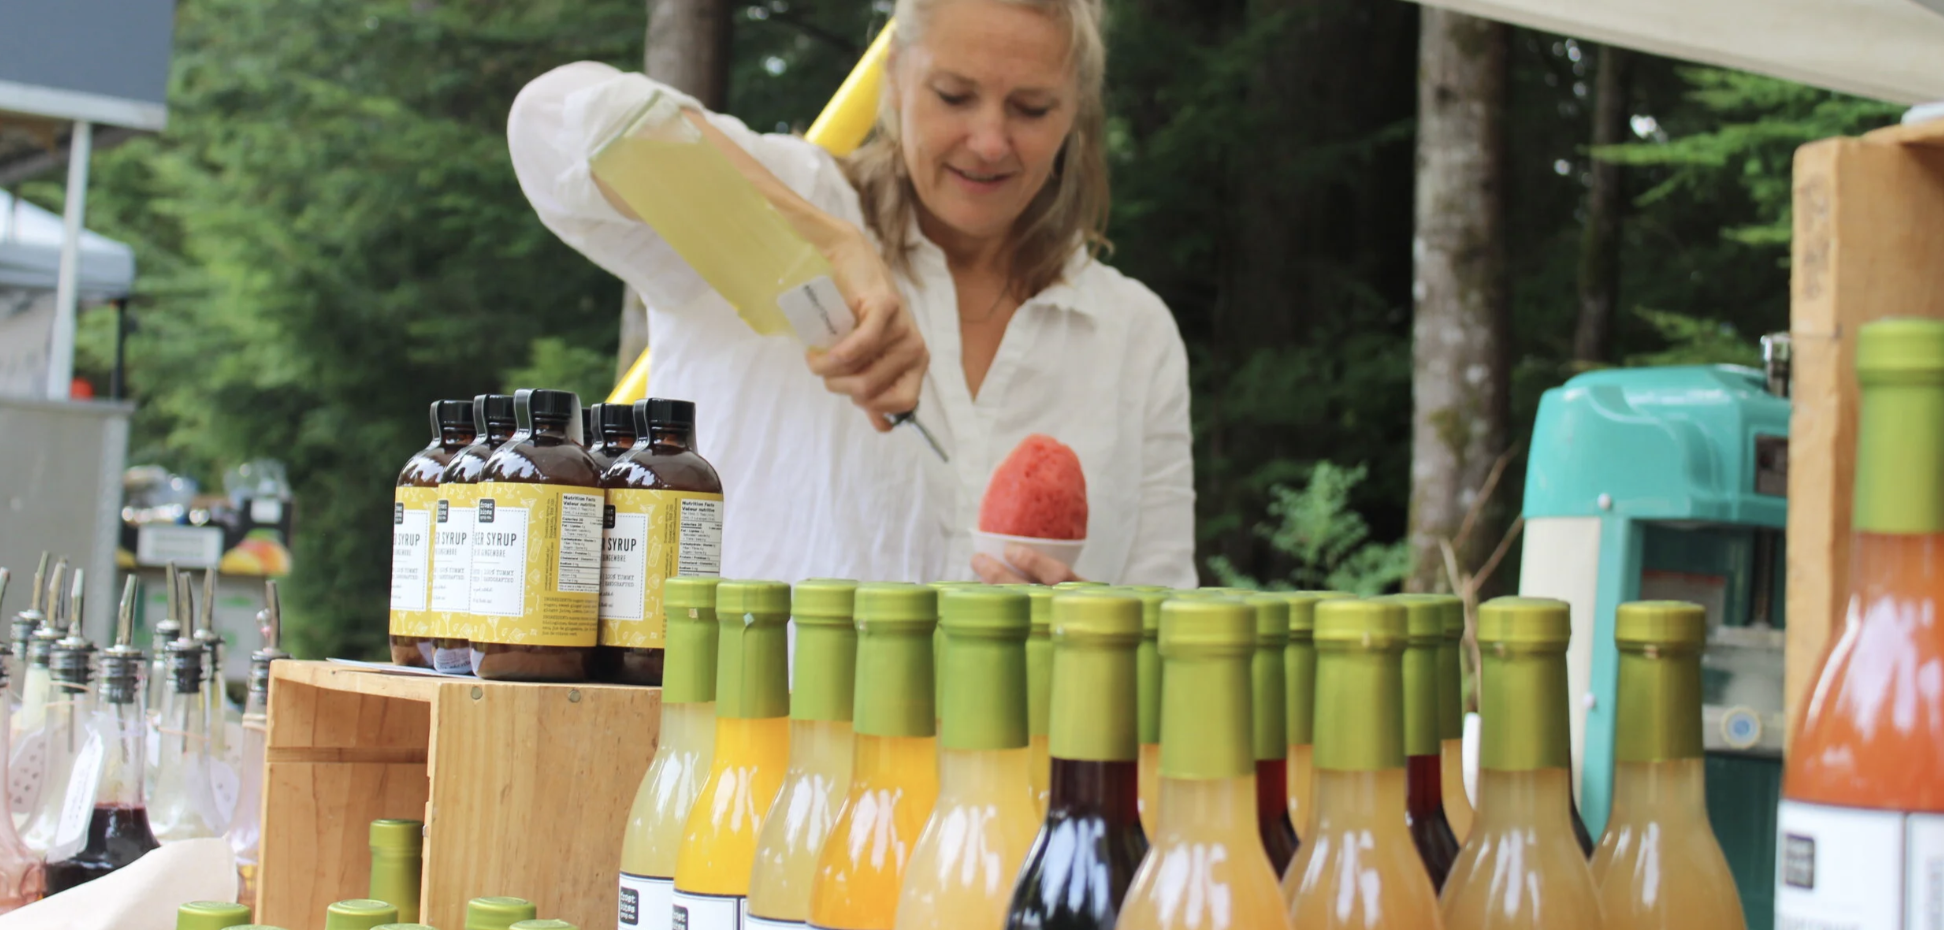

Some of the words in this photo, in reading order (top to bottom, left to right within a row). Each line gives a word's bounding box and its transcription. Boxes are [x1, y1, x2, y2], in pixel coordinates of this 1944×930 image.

[398, 533, 421, 547] SYRUP
[442, 531, 467, 546] SYRUP
[486, 531, 517, 547] SYRUP
[608, 537, 637, 552] SYRUP
